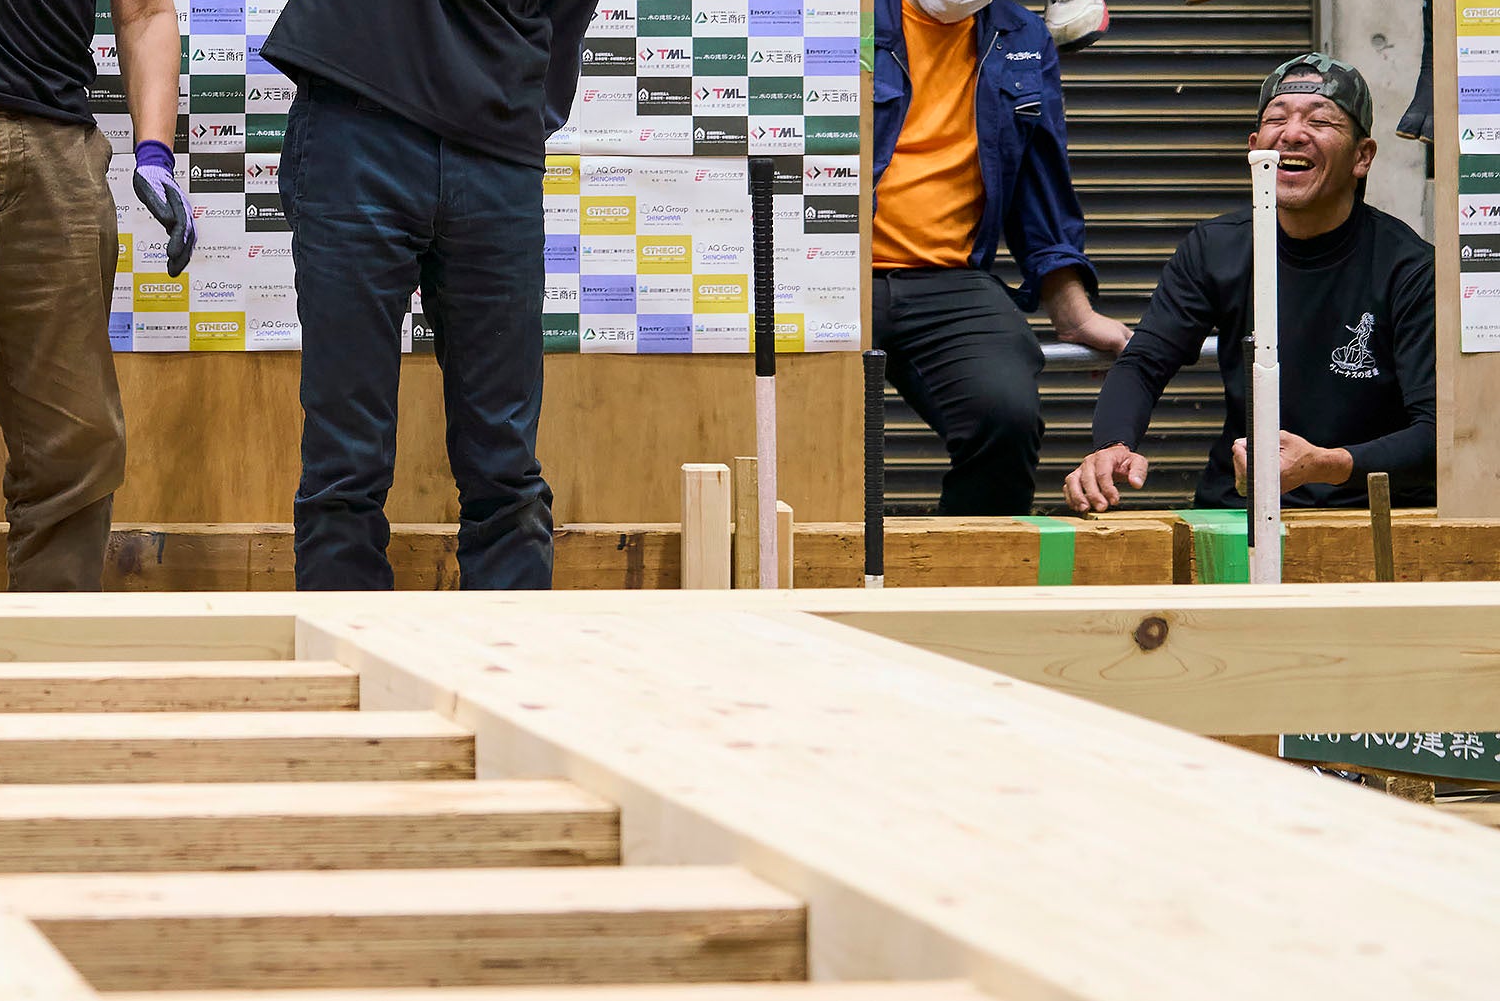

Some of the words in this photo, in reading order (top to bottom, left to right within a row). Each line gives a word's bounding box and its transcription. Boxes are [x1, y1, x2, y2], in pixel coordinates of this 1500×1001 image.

[600, 10, 634, 20] TML
[710, 14, 746, 24] 大三商行
[207, 51, 243, 61] 大三商行
[656, 49, 691, 59] TML
[766, 53, 801, 63] 大三商行
[712, 88, 746, 99] TML
[821, 92, 857, 102] 大三商行
[209, 125, 243, 136] TML
[768, 127, 803, 138] TML
[609, 166, 633, 175] Group
[823, 167, 858, 178] TML
[588, 207, 627, 215] SYNEGIC
[665, 205, 688, 214] Group
[644, 246, 683, 254] SYNEGIC
[721, 244, 744, 253] Group
[141, 284, 180, 292] SYNEGIC
[204, 281, 217, 289] AQ
[218, 281, 242, 290] Group
[700, 285, 739, 293] SYNEGIC
[197, 323, 236, 331] SYNEGIC
[260, 321, 273, 329] AQ
[274, 321, 297, 330] Group
[598, 330, 634, 340] 大三商行
[1349, 732, 1500, 763] 木の建築
